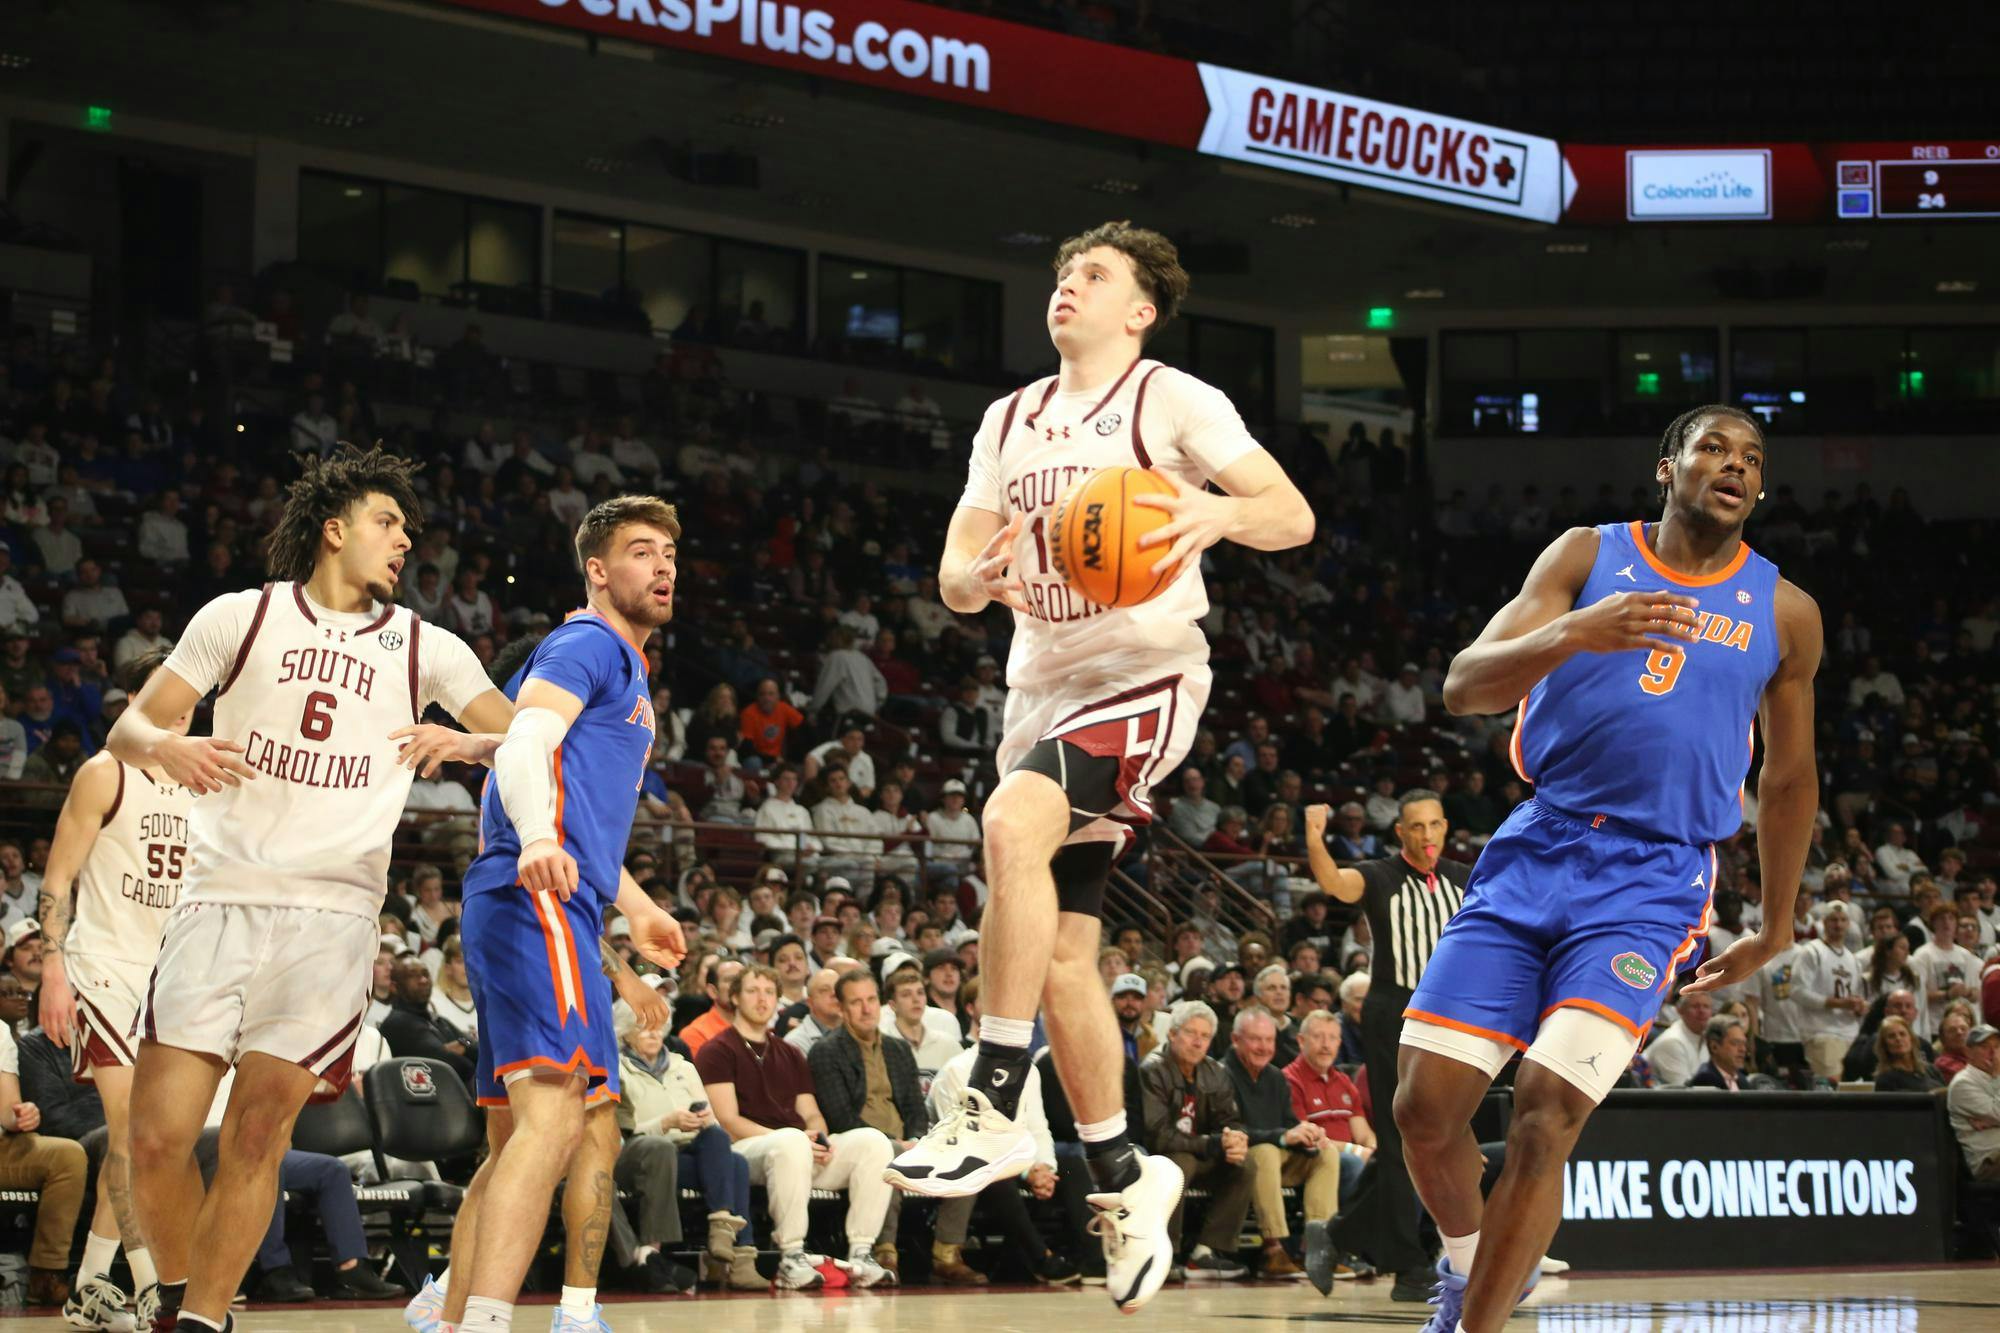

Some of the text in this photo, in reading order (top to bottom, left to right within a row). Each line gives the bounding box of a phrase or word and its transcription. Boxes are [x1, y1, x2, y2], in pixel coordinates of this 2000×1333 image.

[1913, 146, 1949, 159] REB
[1985, 145, 2000, 159] O
[1643, 181, 1753, 200] Colonial Life
[1923, 170, 1939, 186] 9
[1917, 193, 1947, 209] 24
[1007, 466, 1097, 514] SOUT
[1083, 503, 1104, 572] NCAA
[378, 631, 403, 650] SEC
[278, 648, 376, 701] SOUTH
[1638, 649, 1686, 695] 9
[300, 691, 338, 742] 6
[245, 730, 371, 789] CAROLINA
[147, 843, 187, 880] 55
[122, 873, 183, 909] CAROLI
[0, 1190, 39, 1202] COCKS
[357, 1190, 410, 1201] AMECOCKS
[1661, 1158, 1917, 1218] CONNECTIONS
